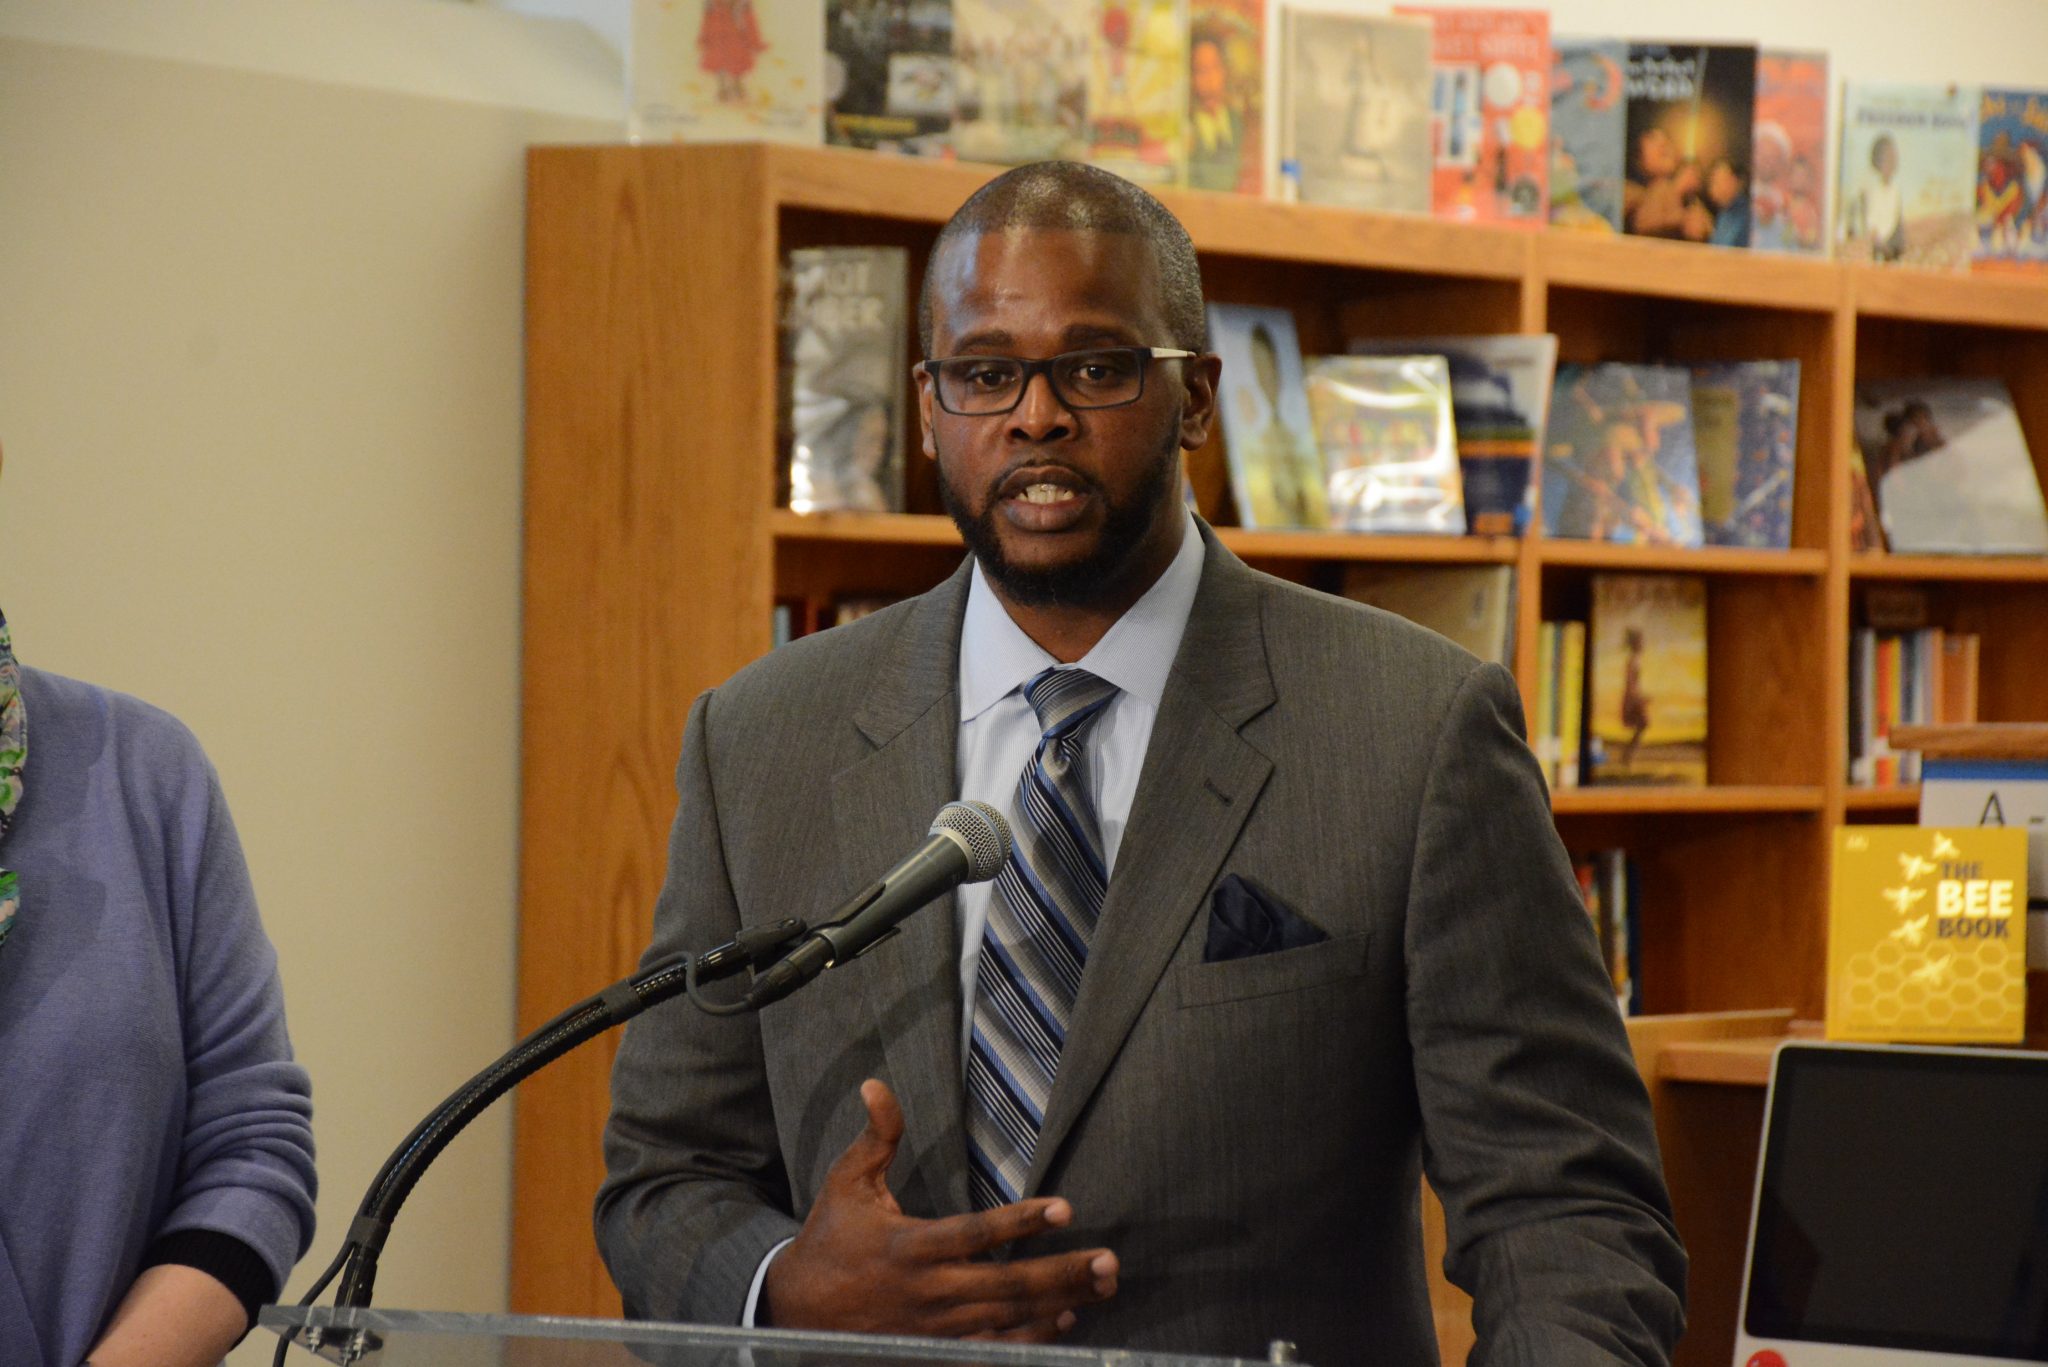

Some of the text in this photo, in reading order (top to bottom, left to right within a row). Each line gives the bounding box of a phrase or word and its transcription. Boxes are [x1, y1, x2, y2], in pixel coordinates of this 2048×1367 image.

[1942, 862, 1982, 879] THE
[1936, 879, 2014, 918] BEE
[1937, 918, 2010, 939] BOOK
